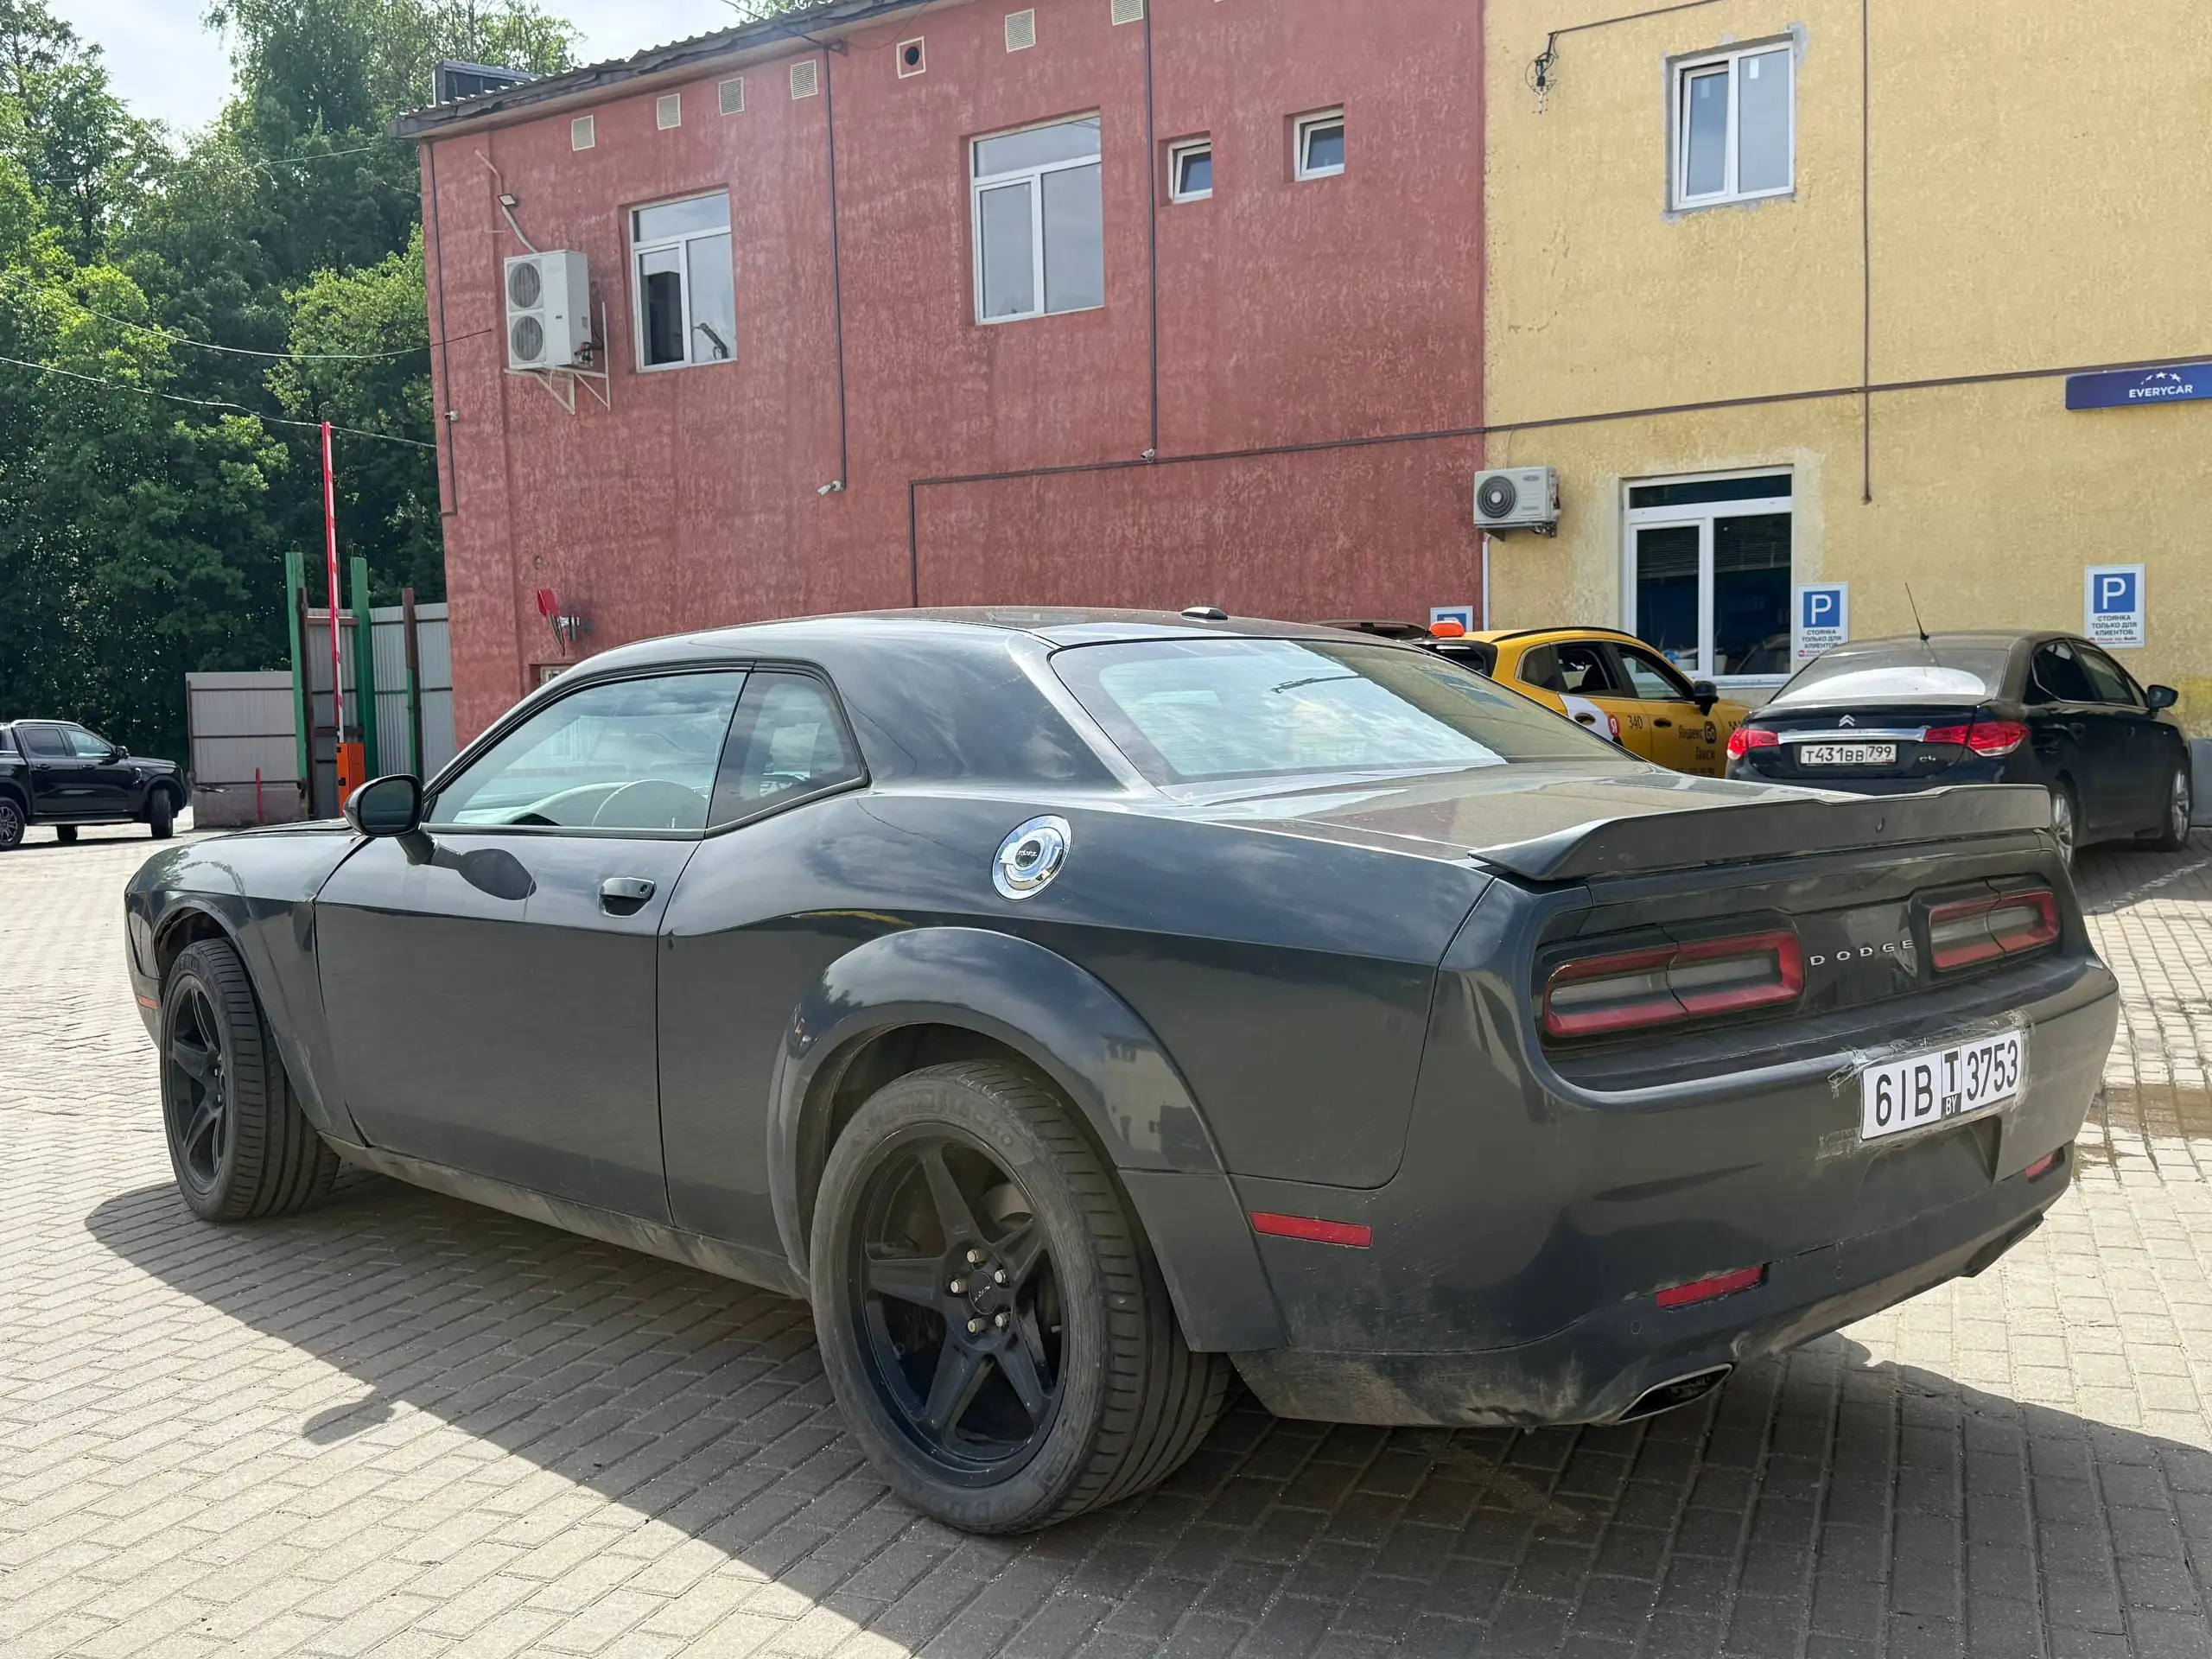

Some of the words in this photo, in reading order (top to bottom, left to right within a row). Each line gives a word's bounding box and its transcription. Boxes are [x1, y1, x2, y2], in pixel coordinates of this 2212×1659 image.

[2129, 385, 2193, 397] EVERYCAR
[2102, 577, 2126, 609] P
[1811, 594, 1832, 625] P
[1627, 715, 1643, 729] 340
[1679, 724, 1704, 740] Яндекс
[1695, 747, 1716, 760] Такси
[1868, 746, 1892, 758] 799
[1809, 939, 1915, 966] DODGE
[1966, 1039, 2018, 1101] 3753
[1945, 1096, 1958, 1115] BY
